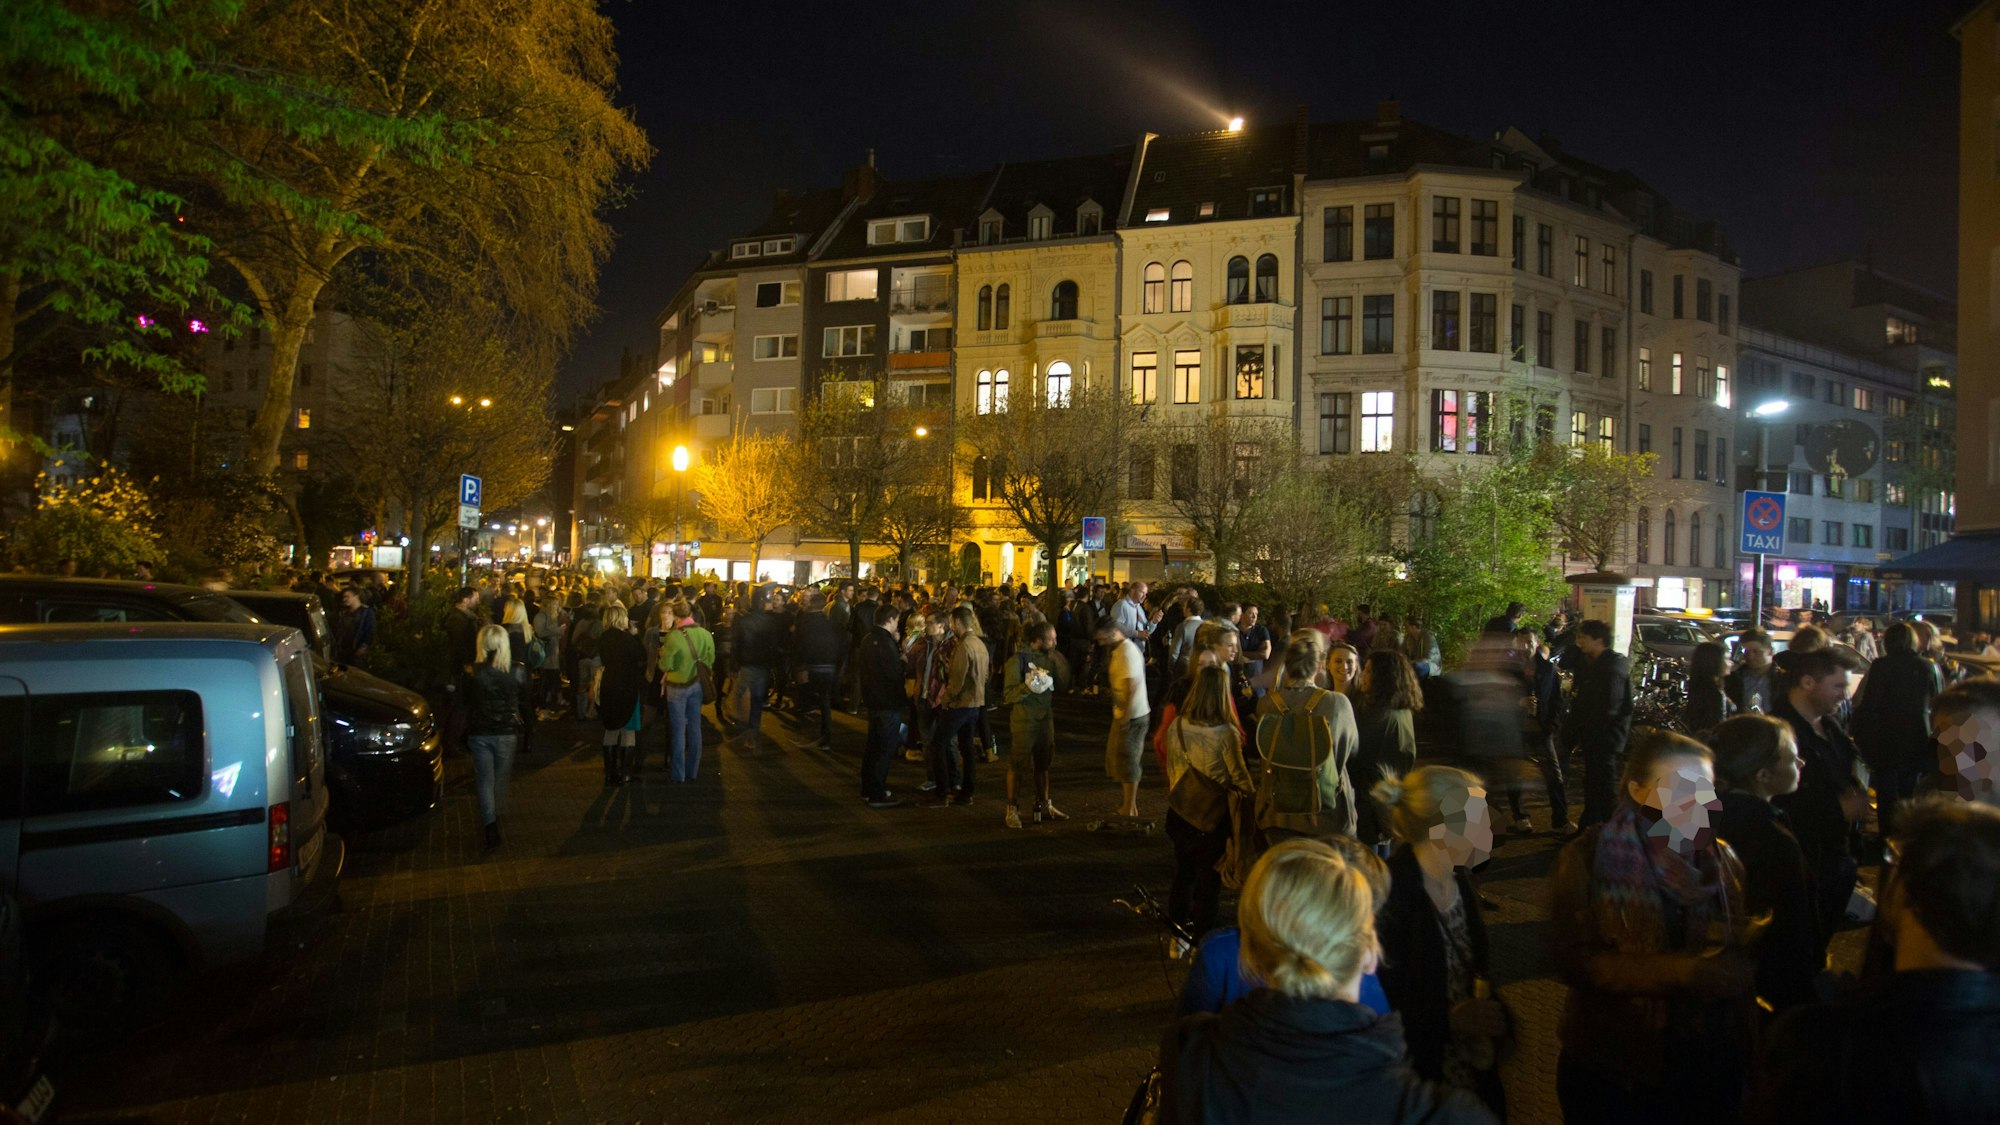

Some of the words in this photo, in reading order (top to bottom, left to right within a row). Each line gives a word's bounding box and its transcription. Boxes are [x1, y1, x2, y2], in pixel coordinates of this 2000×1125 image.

[465, 479, 477, 501] P
[1085, 539, 1103, 548] TAXI
[1745, 533, 1780, 549] TAXI
